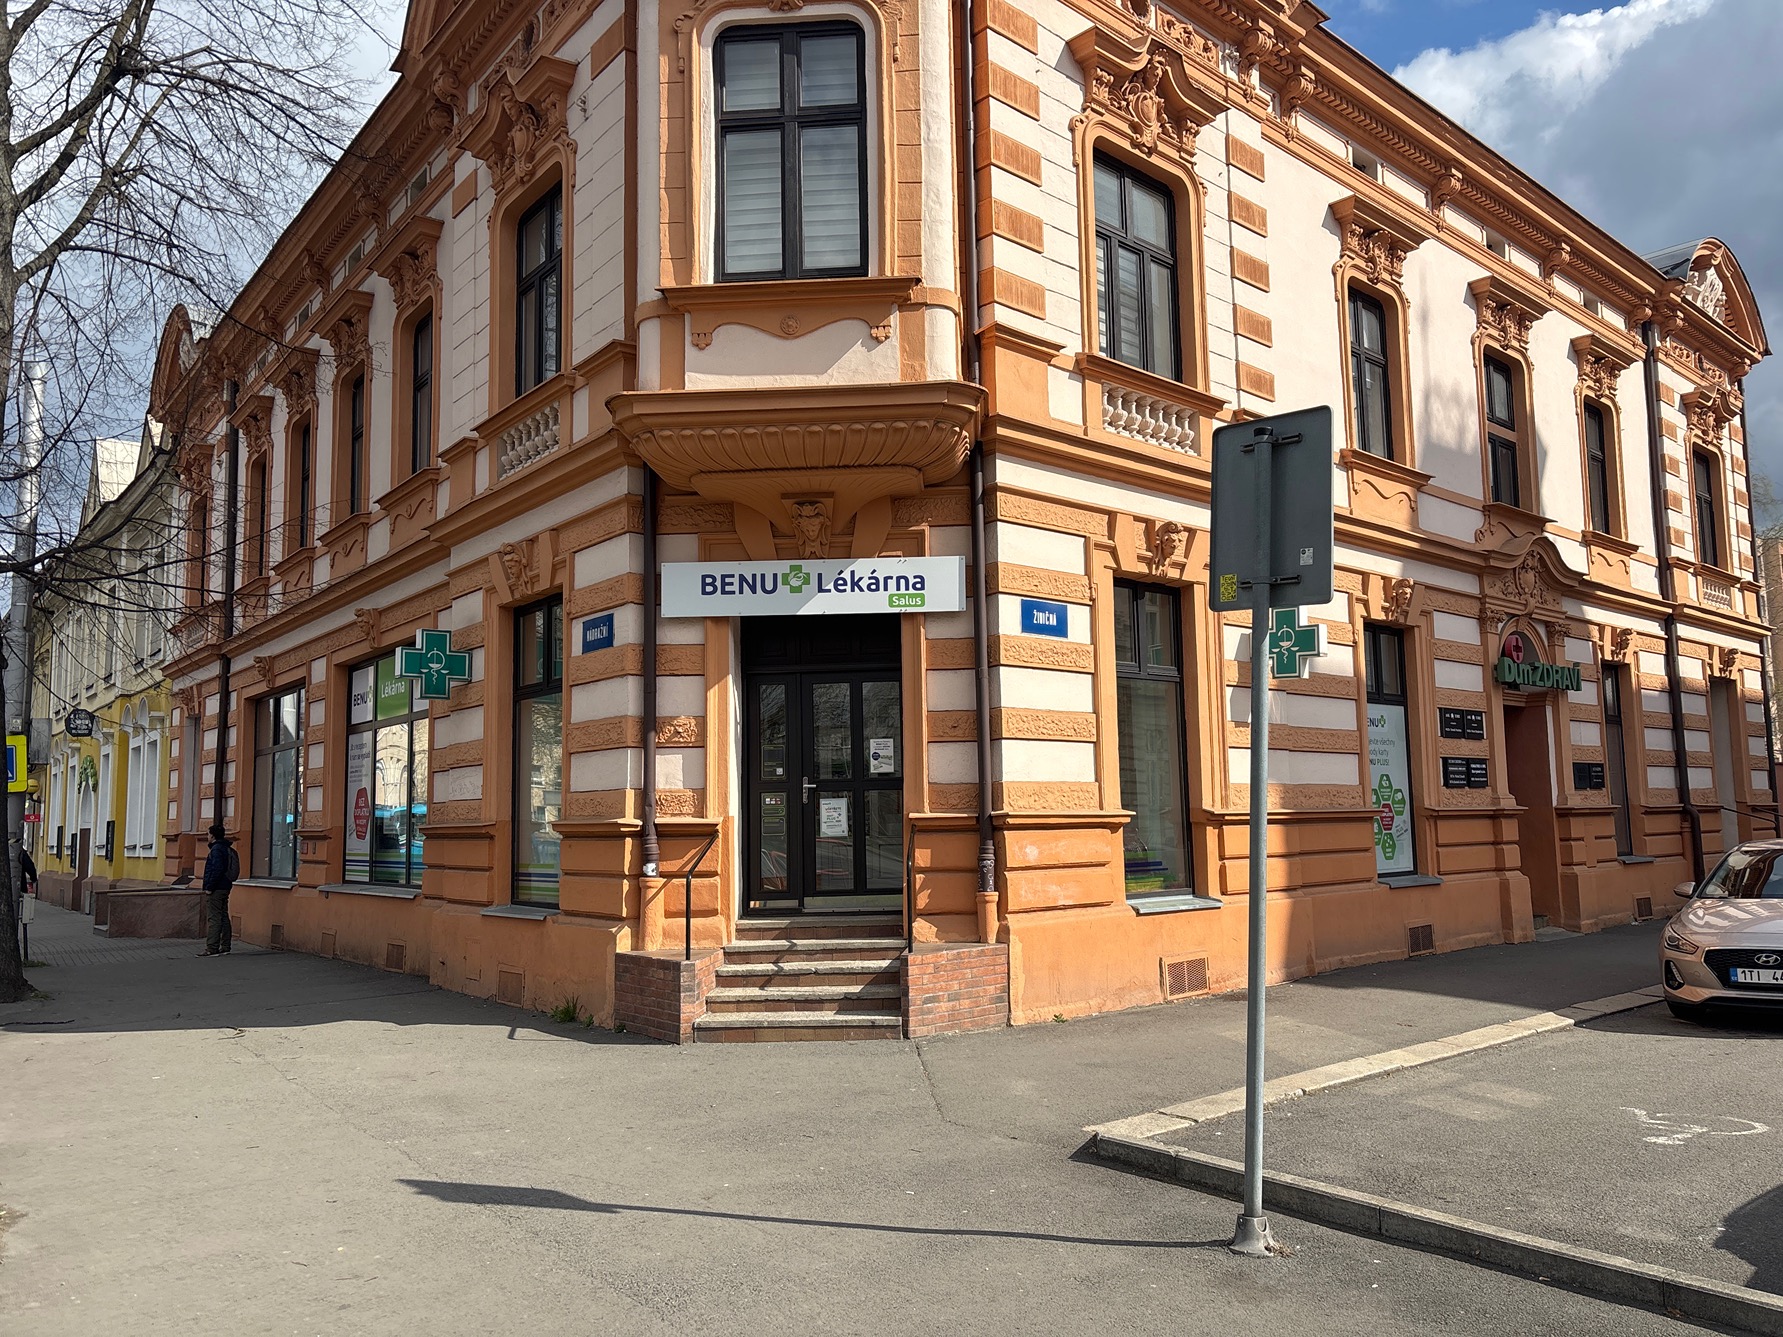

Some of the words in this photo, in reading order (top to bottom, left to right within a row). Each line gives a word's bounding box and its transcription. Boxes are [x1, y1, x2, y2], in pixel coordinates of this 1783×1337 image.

[700, 572, 779, 596] BENU
[817, 568, 926, 594] Lékárna
[892, 595, 922, 606] Salus
[381, 680, 405, 698] Lékárna
[353, 690, 368, 707] BENU
[1367, 717, 1379, 728] ENU
[1741, 969, 1761, 982] 1TI
